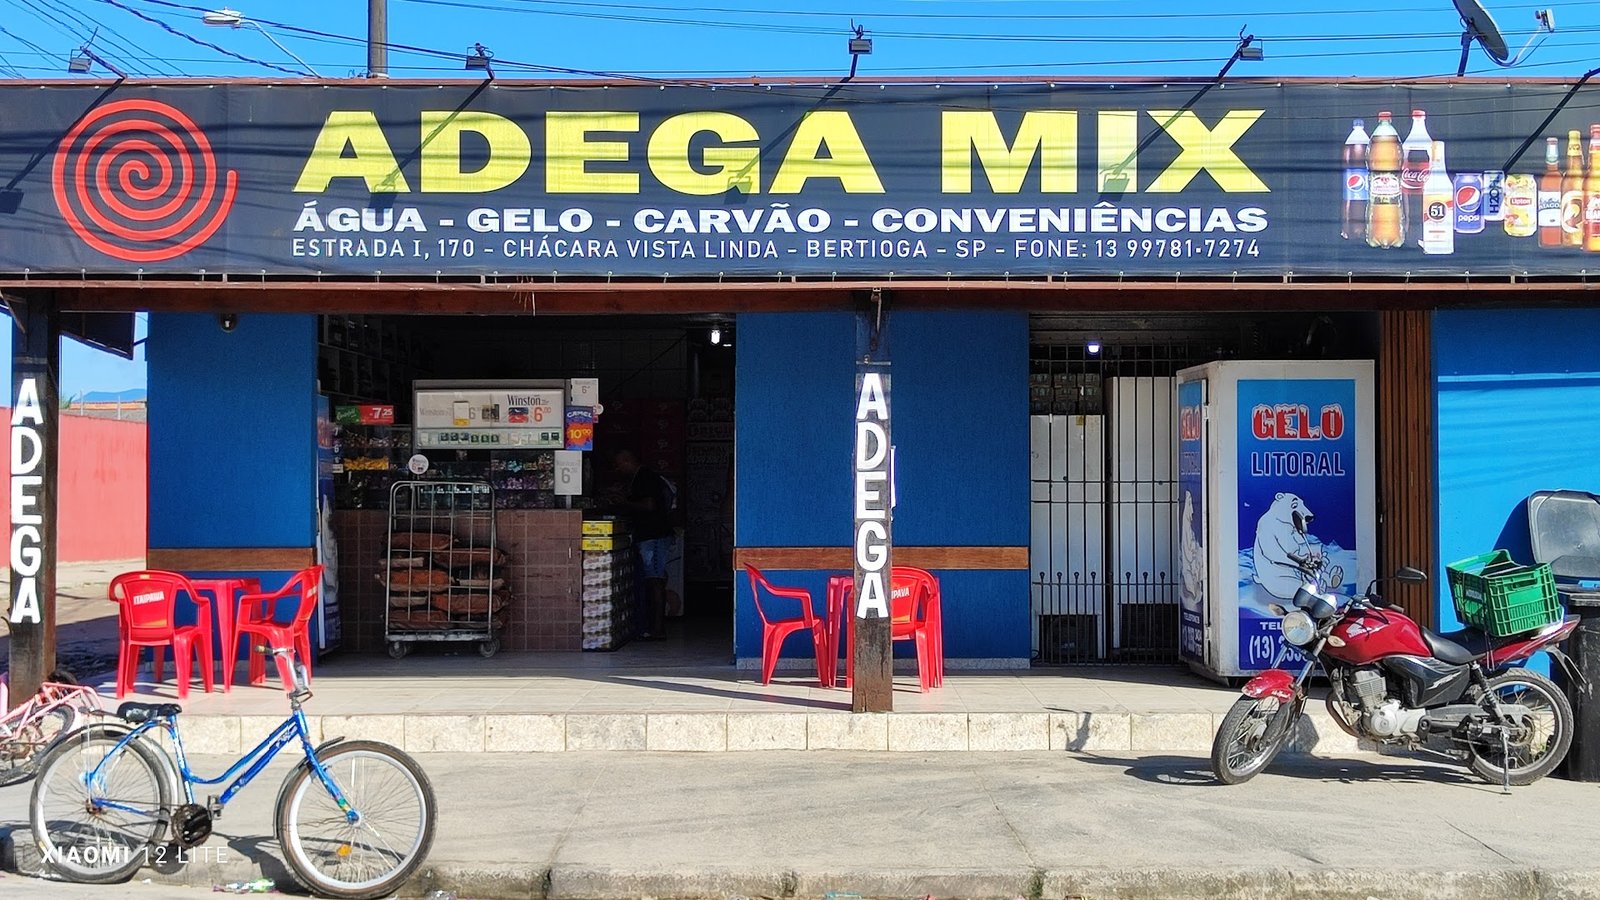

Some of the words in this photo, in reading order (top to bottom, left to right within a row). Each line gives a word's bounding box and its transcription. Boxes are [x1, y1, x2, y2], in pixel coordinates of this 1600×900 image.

[293, 109, 886, 194] ADEGA
[940, 109, 1271, 193] MIX
[292, 201, 428, 232] ÁGUA
[467, 207, 593, 233] GELO
[633, 202, 831, 234] CARVÃO
[871, 202, 1268, 233] CONVENIÊNCIAS
[1430, 206, 1444, 217] 51
[1458, 214, 1480, 223] pepsi
[292, 238, 405, 258] ESTRADA
[437, 238, 474, 258] 170
[503, 234, 619, 258] CHÁCARA
[626, 239, 696, 259] VISTA
[704, 239, 779, 259] LINDA
[806, 239, 928, 259] BERTIOGA
[955, 239, 986, 258] SP
[1015, 239, 1087, 259] FONE:
[1095, 239, 1117, 258] 13
[507, 394, 541, 406] Winston
[567, 410, 592, 418] CAMEL
[1251, 403, 1345, 441] GELO
[1250, 451, 1346, 477] LITORAL
[9, 376, 45, 625] ADEGA
[855, 372, 889, 620] ADEGA
[1249, 635, 1275, 665] (13)
